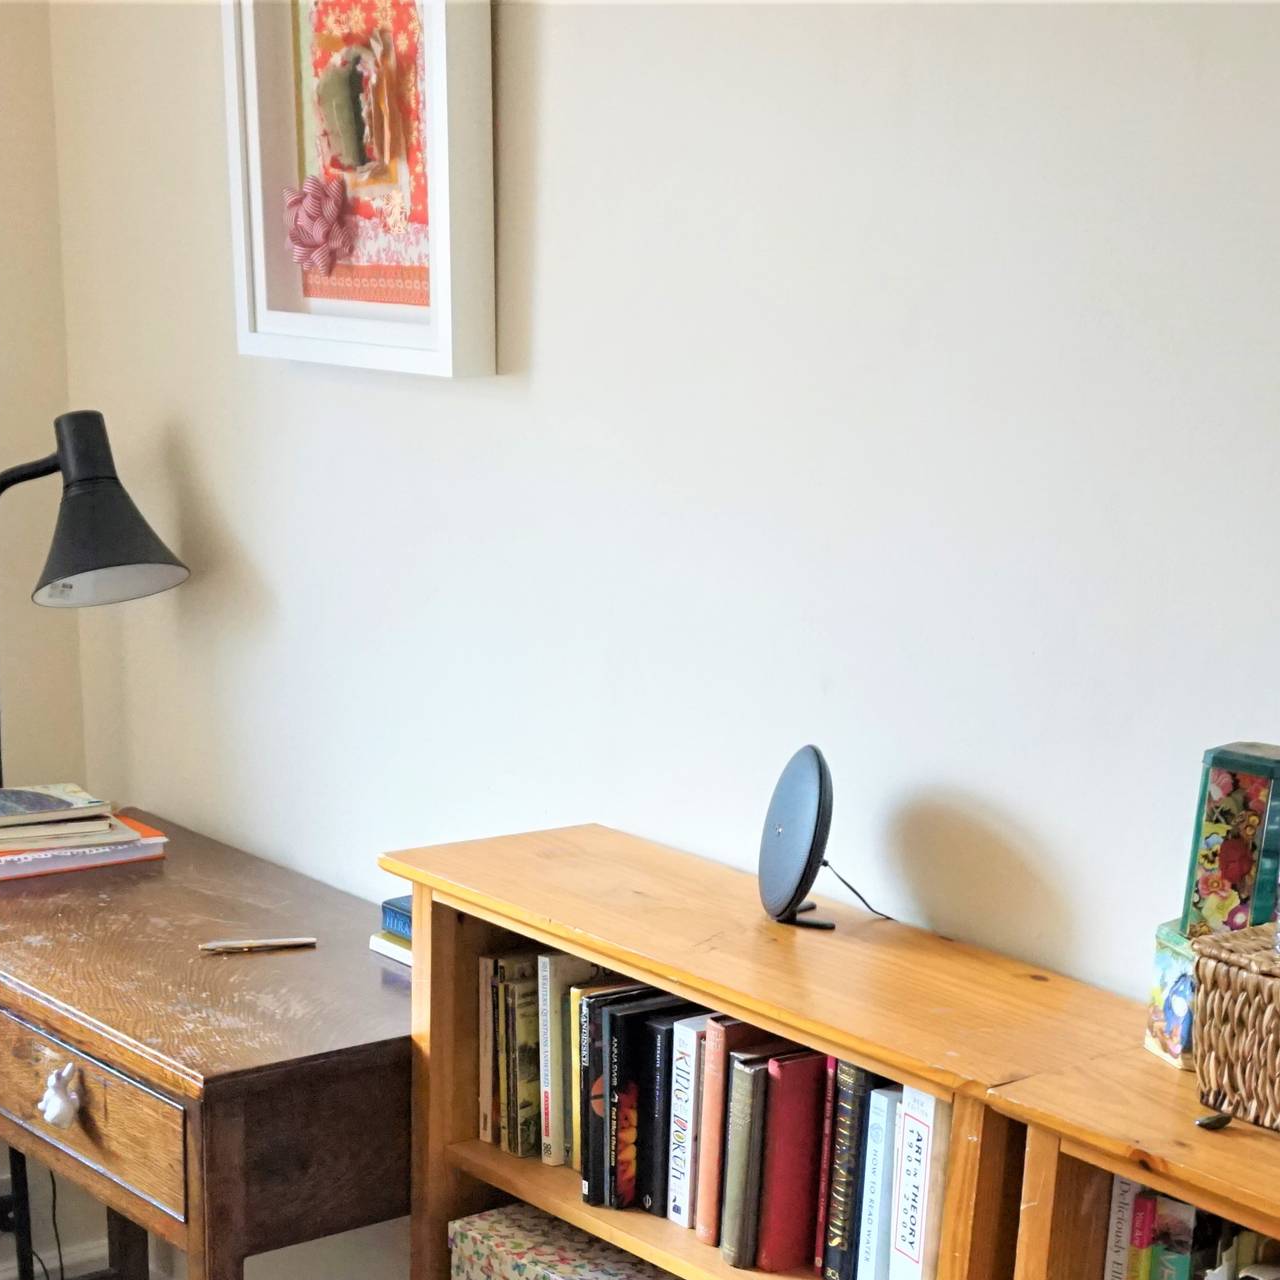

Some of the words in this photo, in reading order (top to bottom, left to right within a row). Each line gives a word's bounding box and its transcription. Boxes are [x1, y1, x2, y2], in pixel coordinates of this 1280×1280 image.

[581, 1007, 589, 1066] KANDINSKY
[871, 1149, 880, 1176] HOW
[913, 1130, 923, 1165] ART
[869, 1180, 877, 1194] TO
[867, 1198, 875, 1225] READ
[907, 1183, 920, 1250] THEORY
[1112, 1178, 1131, 1255] Deliciously
[864, 1228, 873, 1263] WATER
